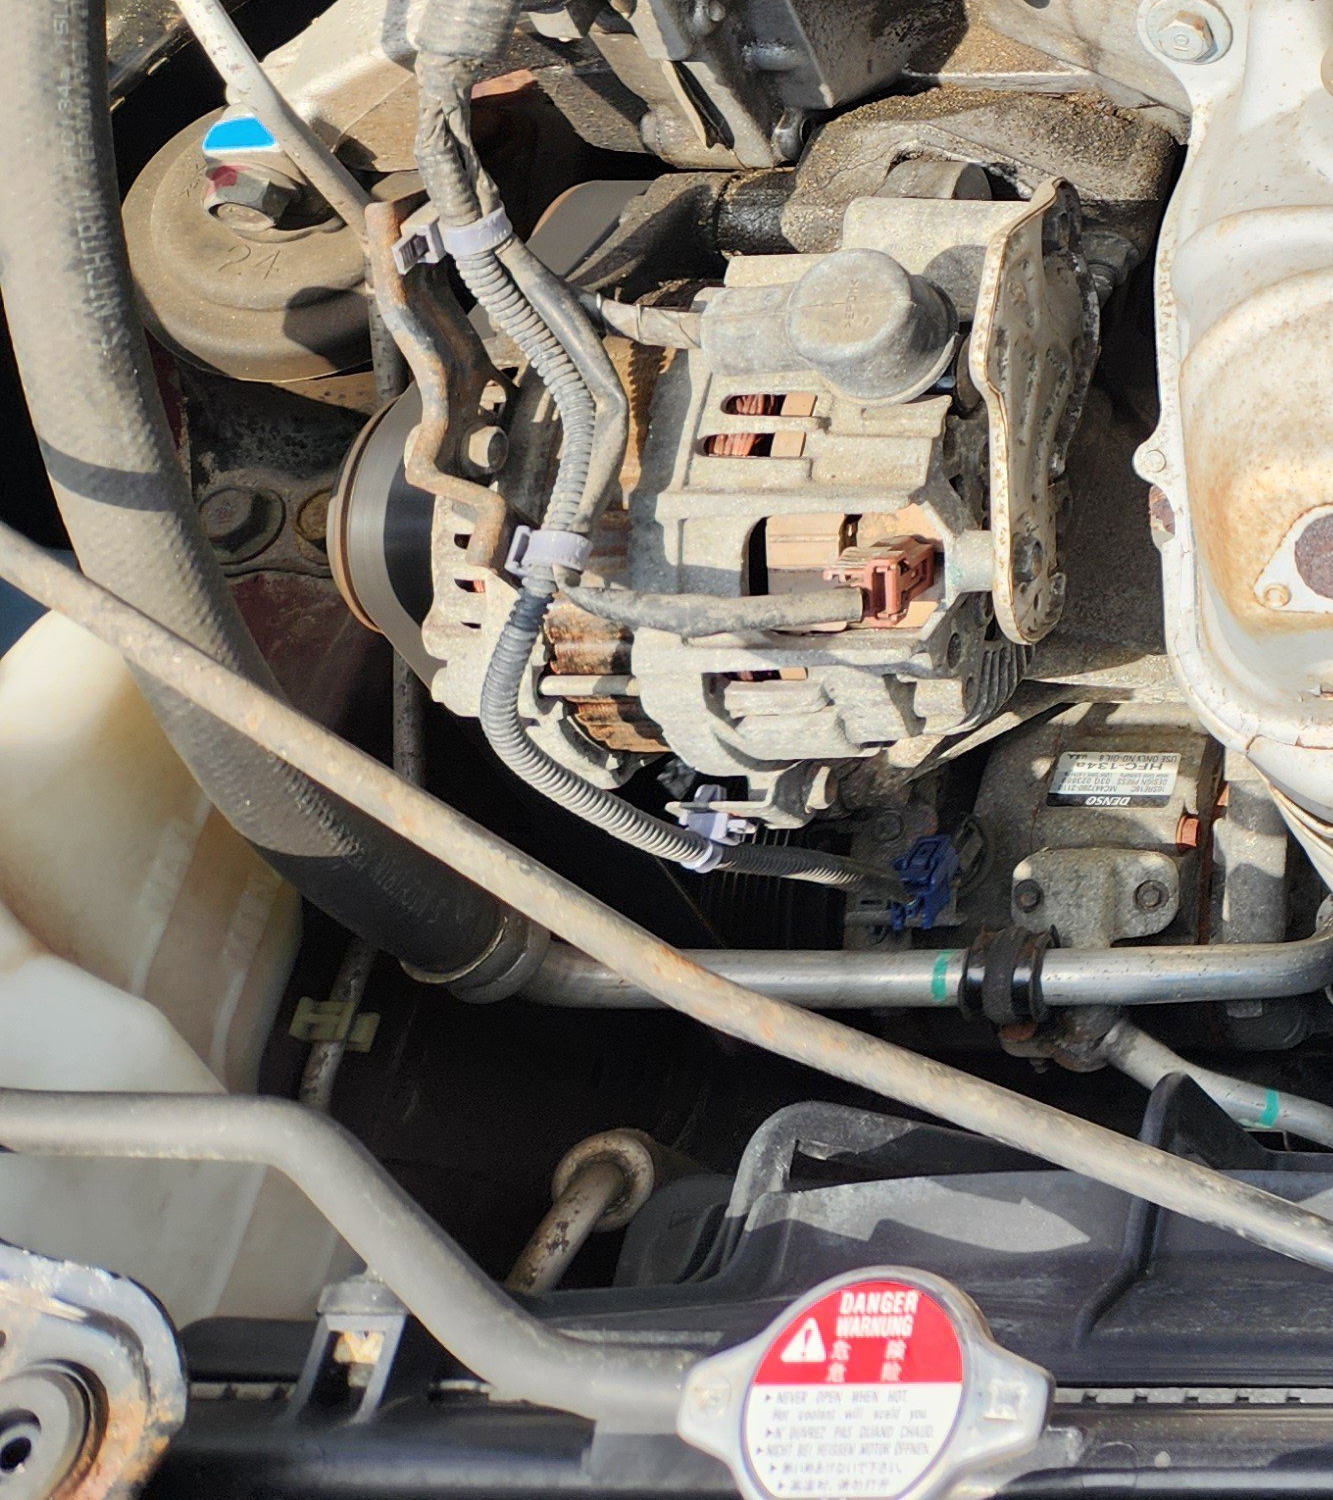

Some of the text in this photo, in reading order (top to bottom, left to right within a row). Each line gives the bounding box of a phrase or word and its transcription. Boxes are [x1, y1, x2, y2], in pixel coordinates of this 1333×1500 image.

[1137, 754, 1159, 763] ONLY
[1161, 755, 1177, 763] USE
[1075, 762, 1164, 771] HFC-134a
[1085, 796, 1132, 806] DENSO
[839, 1290, 919, 1315] DANGER
[836, 1315, 914, 1338] WARNUNG
[776, 1391, 808, 1405] NEVER
[815, 1391, 842, 1405] OPEN
[852, 1390, 879, 1404] WHEN
